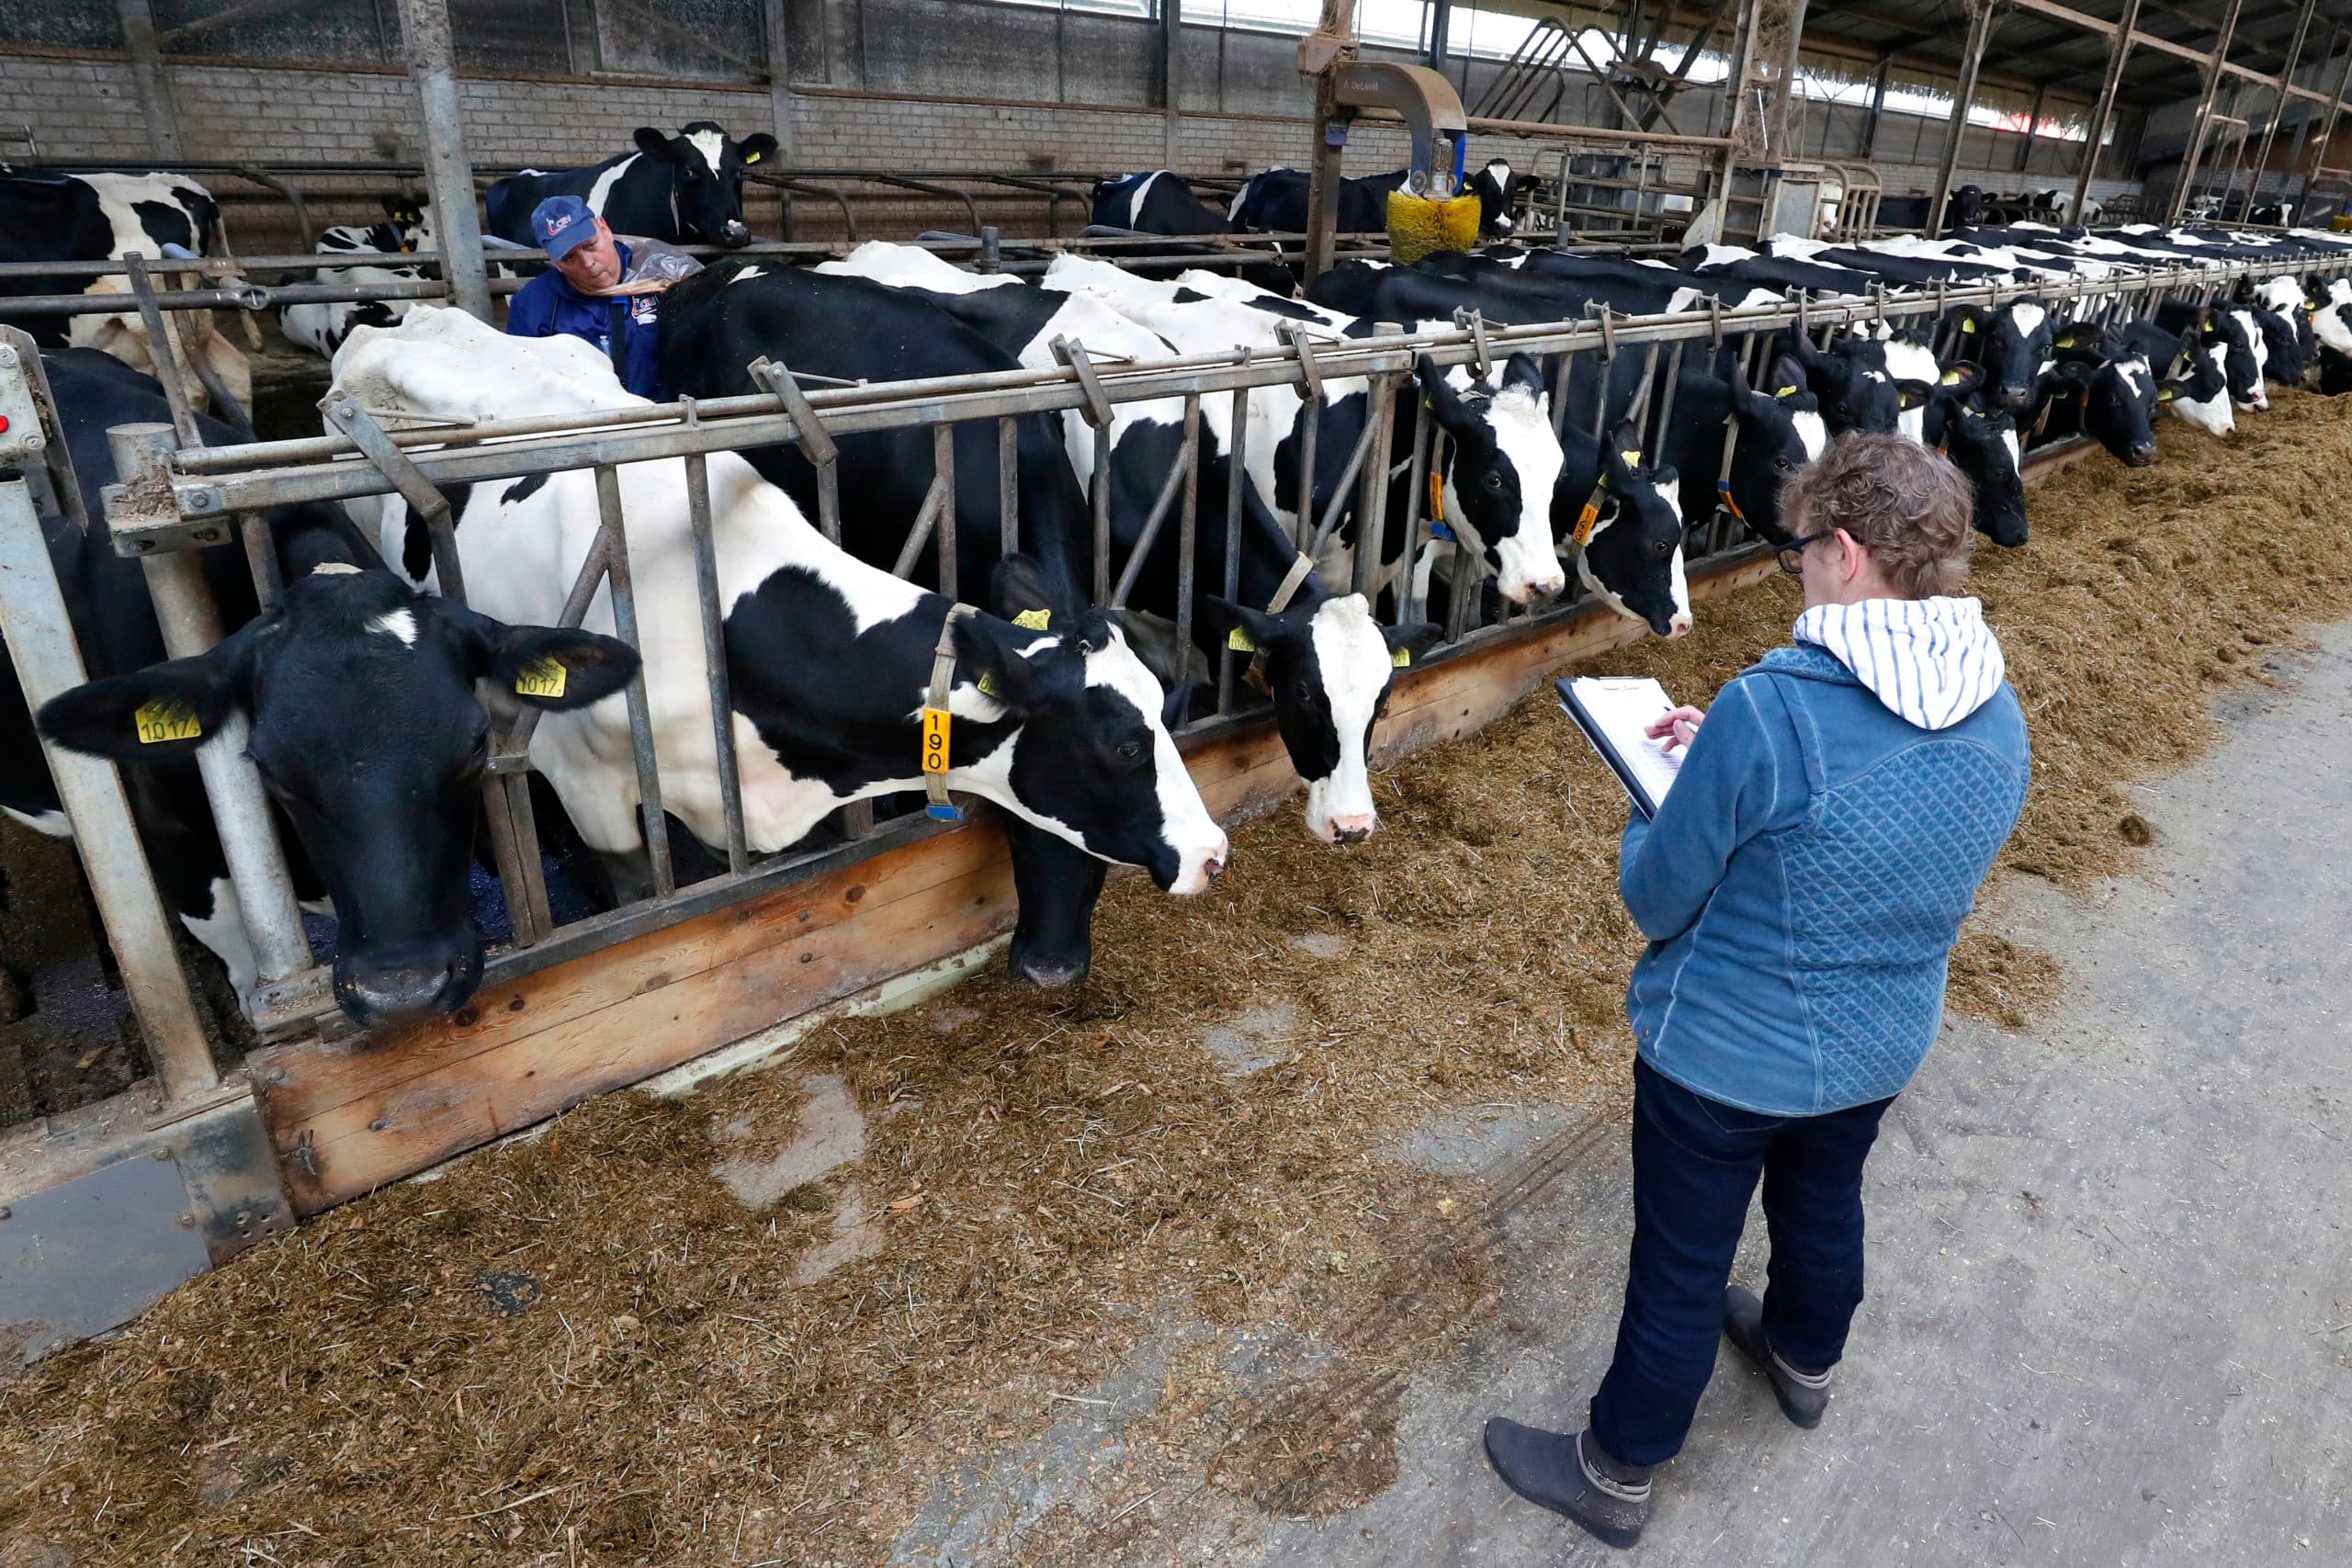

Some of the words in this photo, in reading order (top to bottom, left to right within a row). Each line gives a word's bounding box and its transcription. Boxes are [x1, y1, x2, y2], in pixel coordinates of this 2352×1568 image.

[520, 676, 559, 694] 1017
[141, 719, 187, 741] 1017
[928, 714, 943, 770] 190
